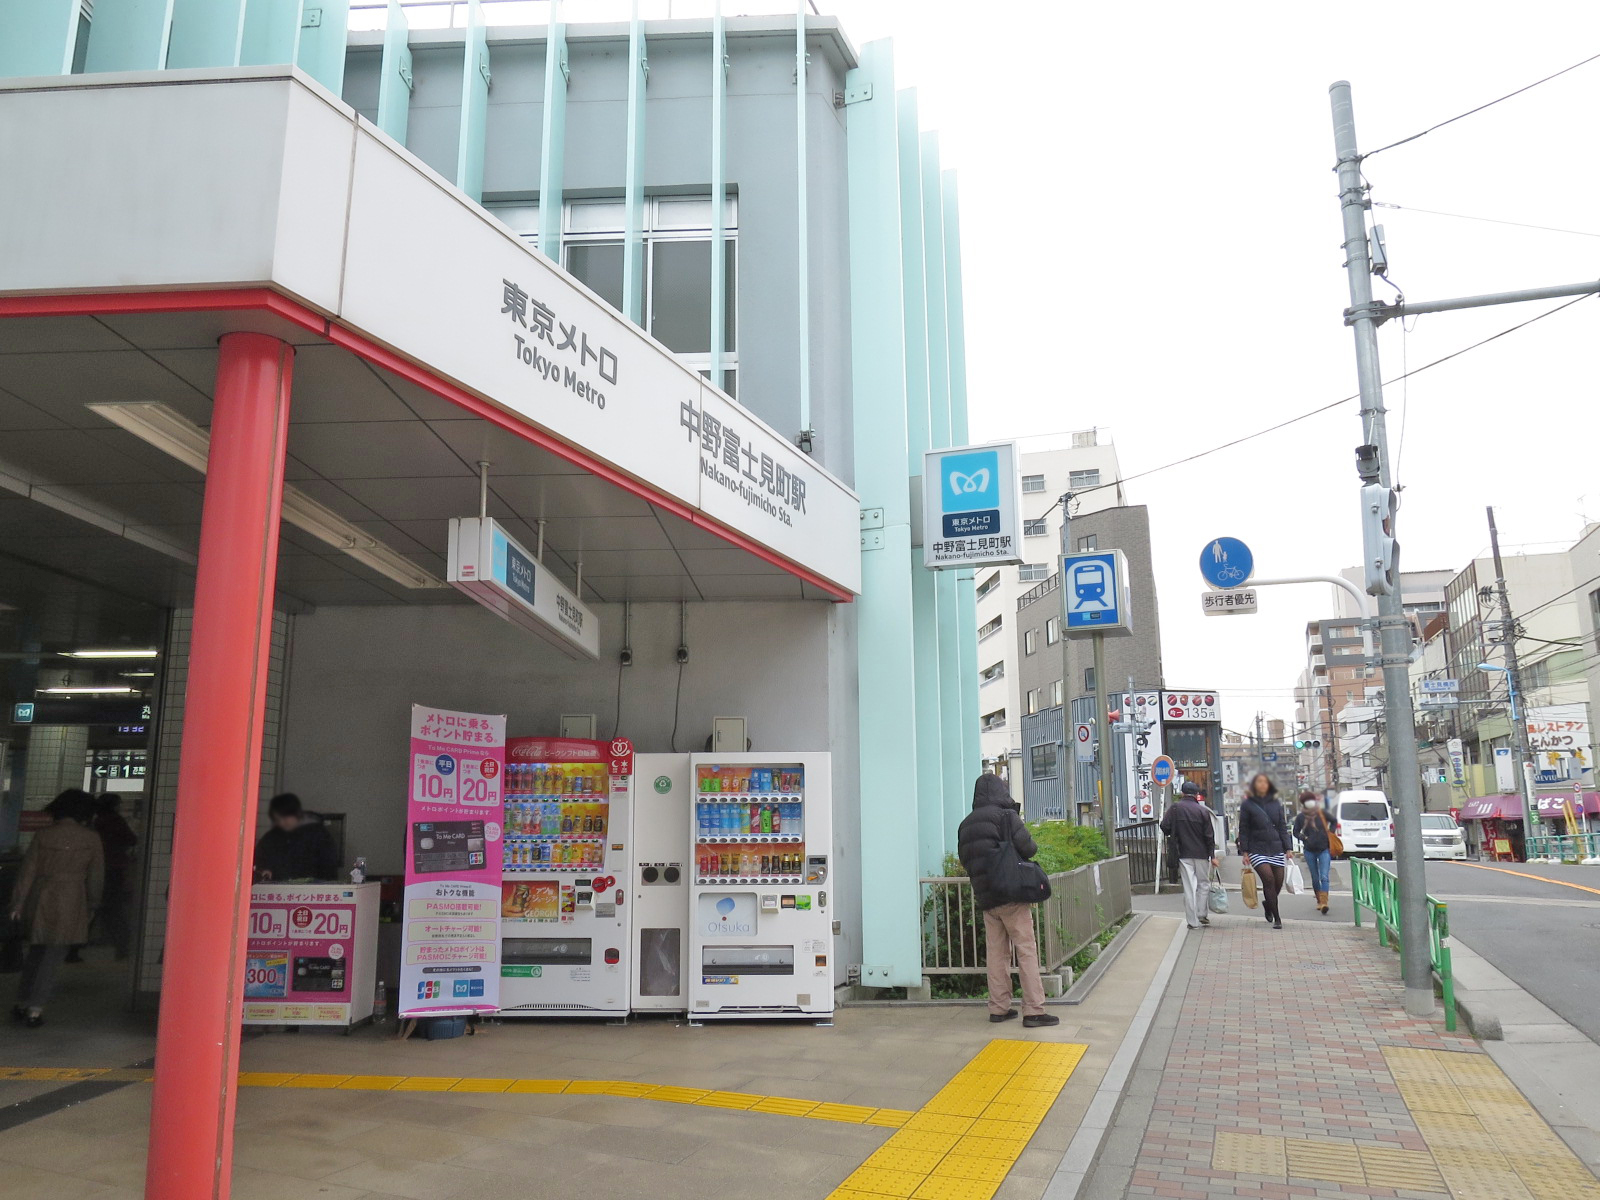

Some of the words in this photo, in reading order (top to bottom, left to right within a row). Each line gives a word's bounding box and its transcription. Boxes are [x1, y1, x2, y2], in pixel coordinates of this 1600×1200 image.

[501, 278, 618, 386] 東京メトロ
[513, 334, 561, 382] Tokyo
[564, 366, 606, 410] Metro
[680, 399, 807, 515] 中野富士見町駅
[700, 456, 777, 517] Nakano-fujimicho
[778, 508, 793, 528] Sta.
[952, 515, 990, 527] 東京メトロ
[973, 524, 989, 532] Metro
[932, 536, 1012, 554] 中野富士見町駅
[935, 550, 995, 561] Nakano-fujimicho
[996, 549, 1010, 557] Sta.
[511, 556, 532, 583] 東京メトロ
[1204, 592, 1255, 608] 歩行者優先
[426, 713, 494, 731] メトロに乗る、
[1169, 709, 1183, 717] 均一
[1185, 707, 1216, 719] 135円
[420, 725, 498, 744] ポイント貯まる。
[1530, 735, 1574, 748] とんかつ
[419, 773, 453, 799] 10円
[463, 777, 497, 802] 20円
[436, 889, 475, 897] おトクな機能
[524, 909, 558, 918] GEORGIA
[708, 921, 750, 933] Otsuka
